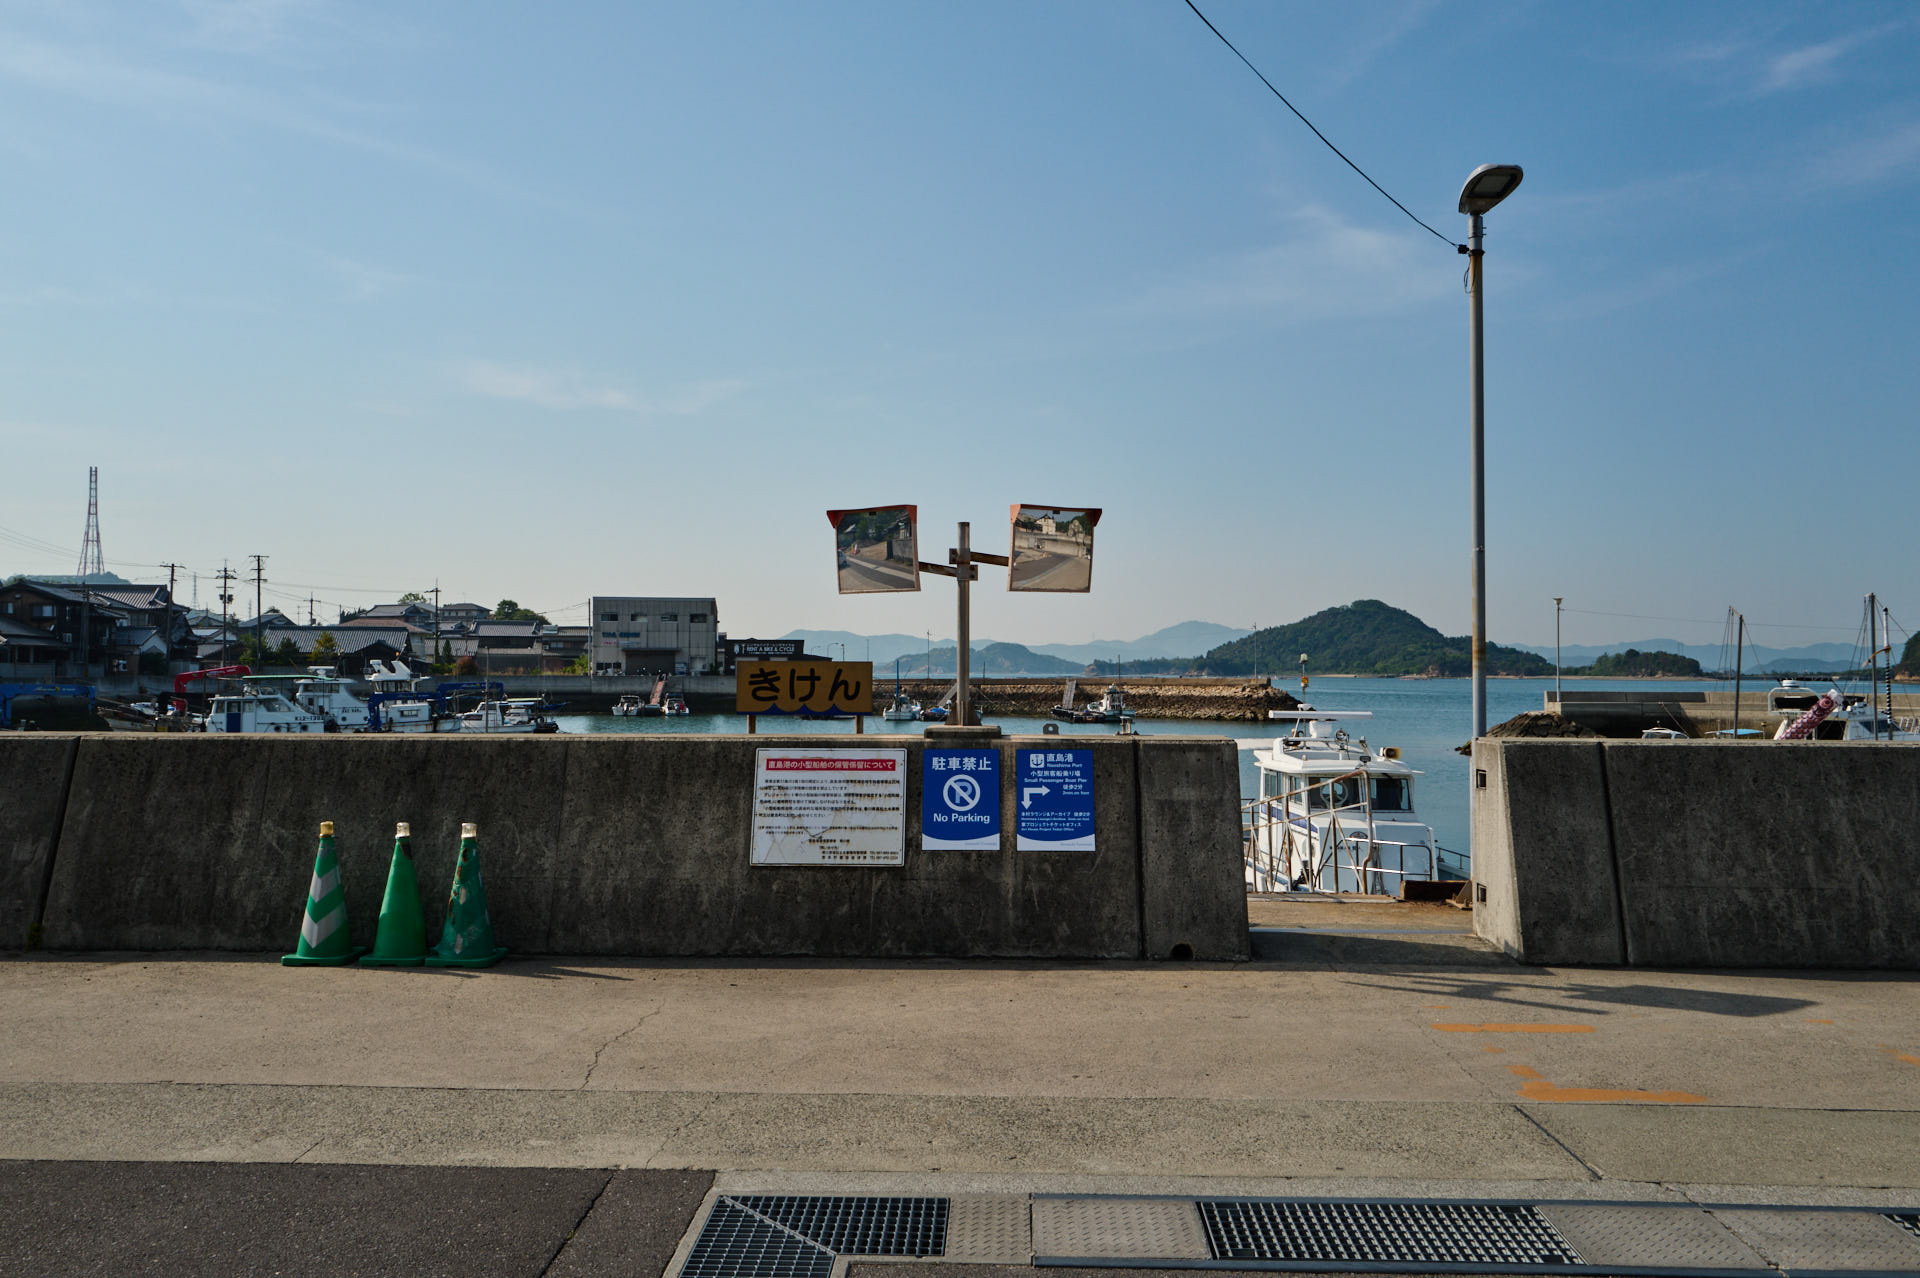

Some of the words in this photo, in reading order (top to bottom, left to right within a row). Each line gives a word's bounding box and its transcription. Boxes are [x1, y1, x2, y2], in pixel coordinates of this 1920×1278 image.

[748, 667, 861, 702] きけん
[1046, 753, 1073, 762] 直島港
[932, 757, 992, 771] 駐車禁止
[933, 813, 948, 822] No
[951, 813, 990, 824] Parking
